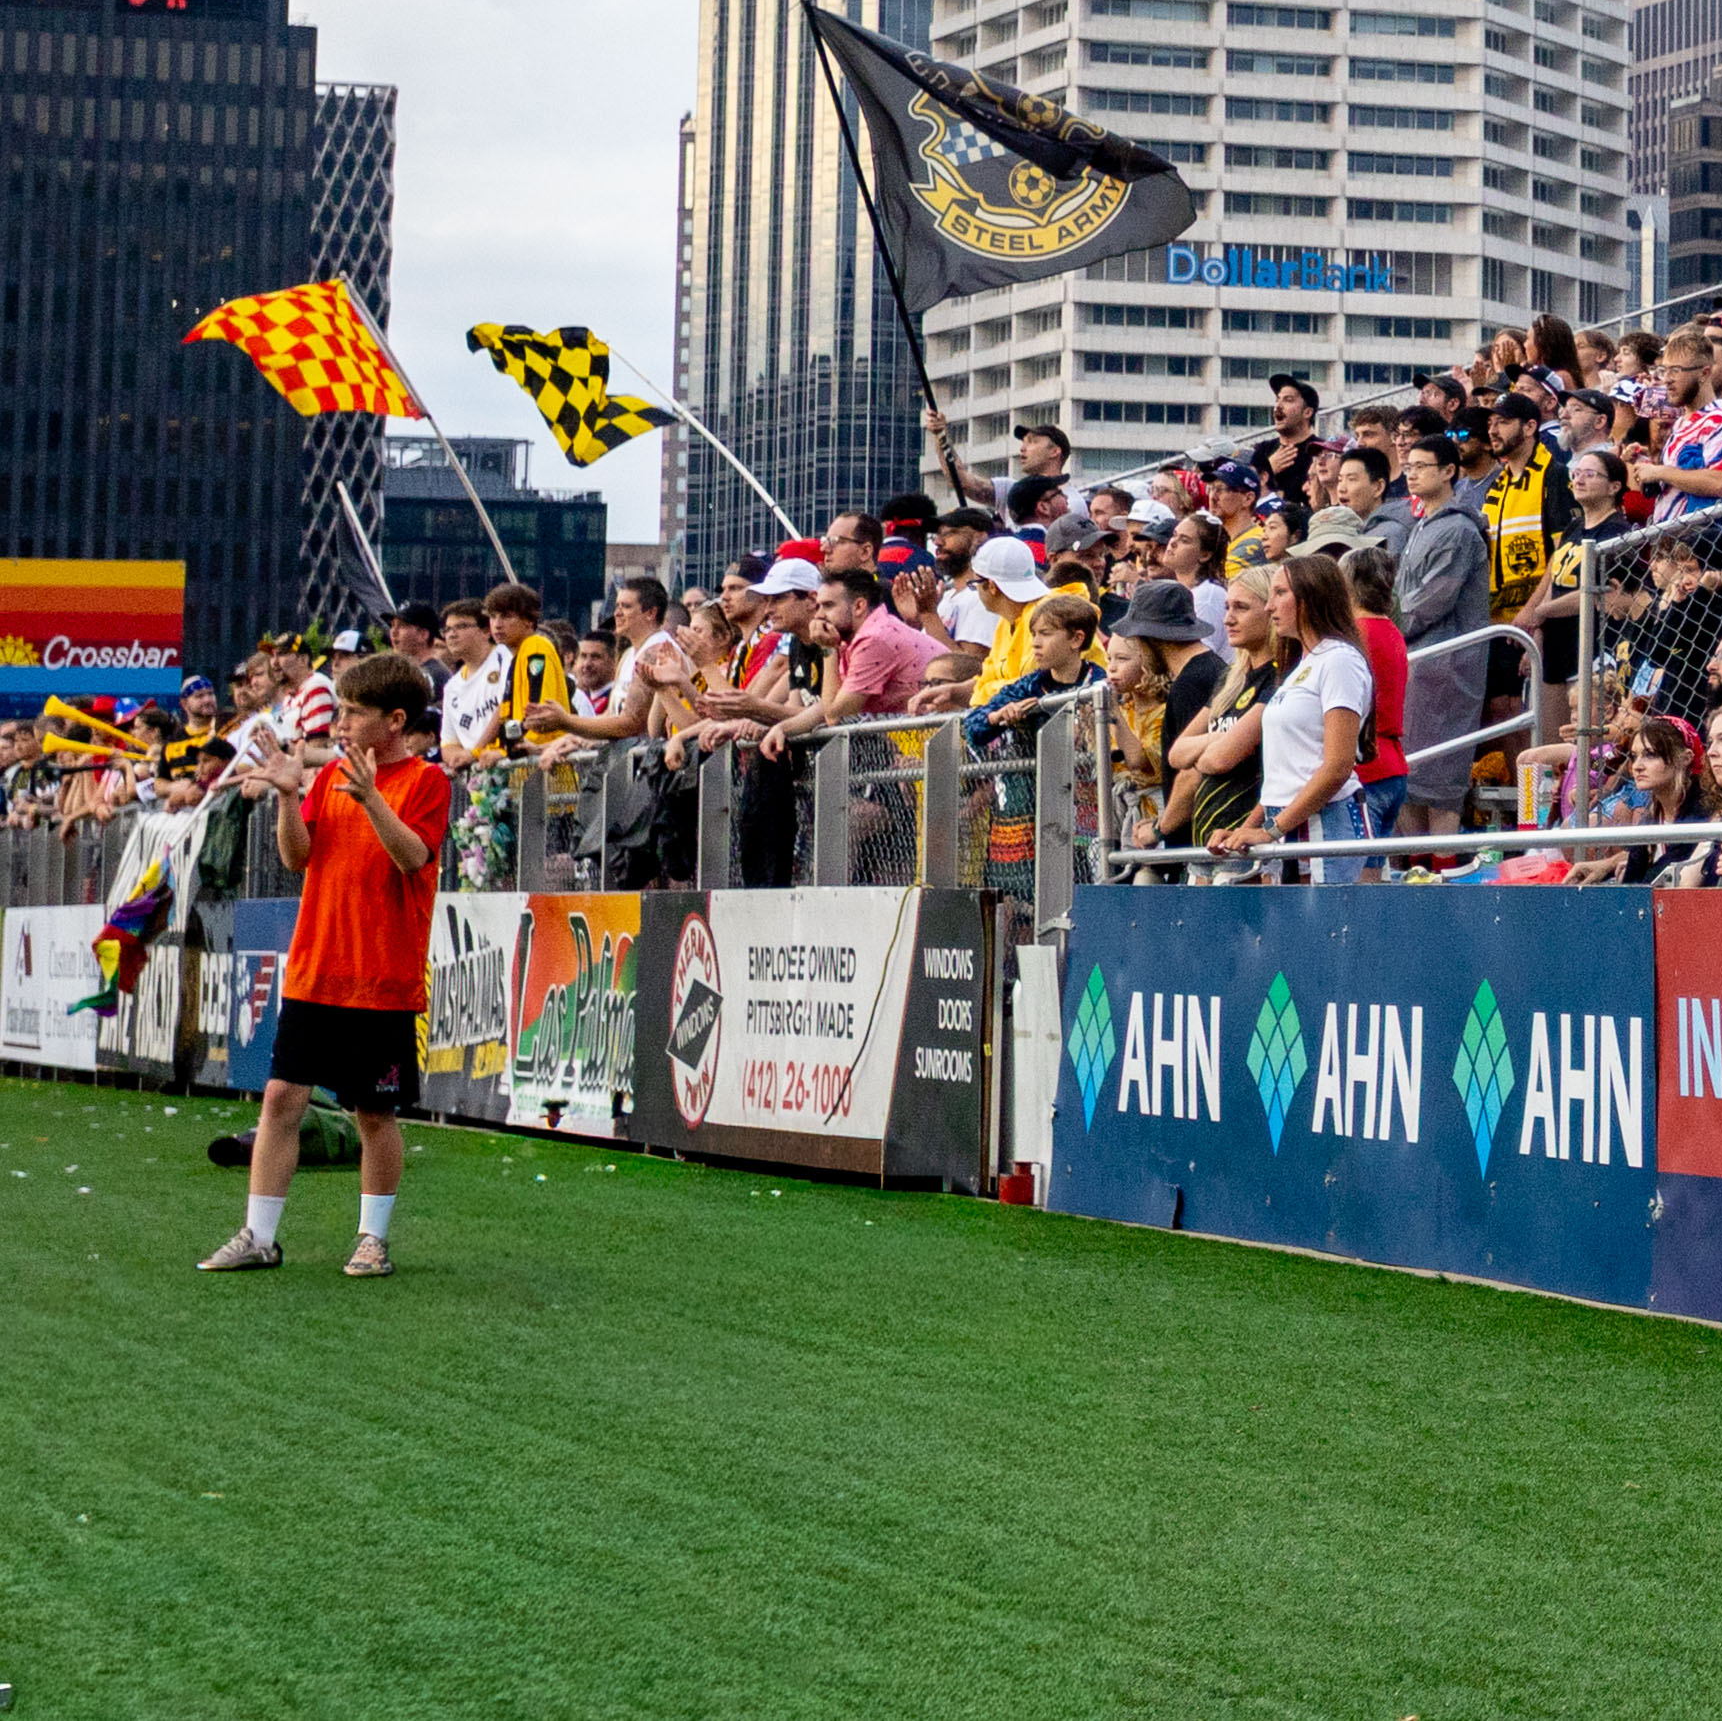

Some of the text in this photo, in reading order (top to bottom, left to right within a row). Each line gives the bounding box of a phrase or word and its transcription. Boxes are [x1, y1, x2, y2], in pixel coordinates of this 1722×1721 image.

[951, 179, 1120, 251] STEEL ARMY
[44, 635, 178, 670] Crossbar
[476, 696, 499, 724] AHN
[675, 927, 712, 1007] THERMO
[748, 945, 857, 984] EMPLOYEE OWNED
[922, 946, 974, 982] WINDOWS
[675, 996, 716, 1051] WINDOWS
[815, 1002, 854, 1040] MADE
[937, 998, 974, 1033] DOORS
[914, 1046, 974, 1084] SUNROOMS
[1118, 992, 1221, 1122] AHN
[1311, 1002, 1422, 1143] AHN
[742, 1059, 777, 1116] (412)
[1519, 1012, 1644, 1168] AHN
